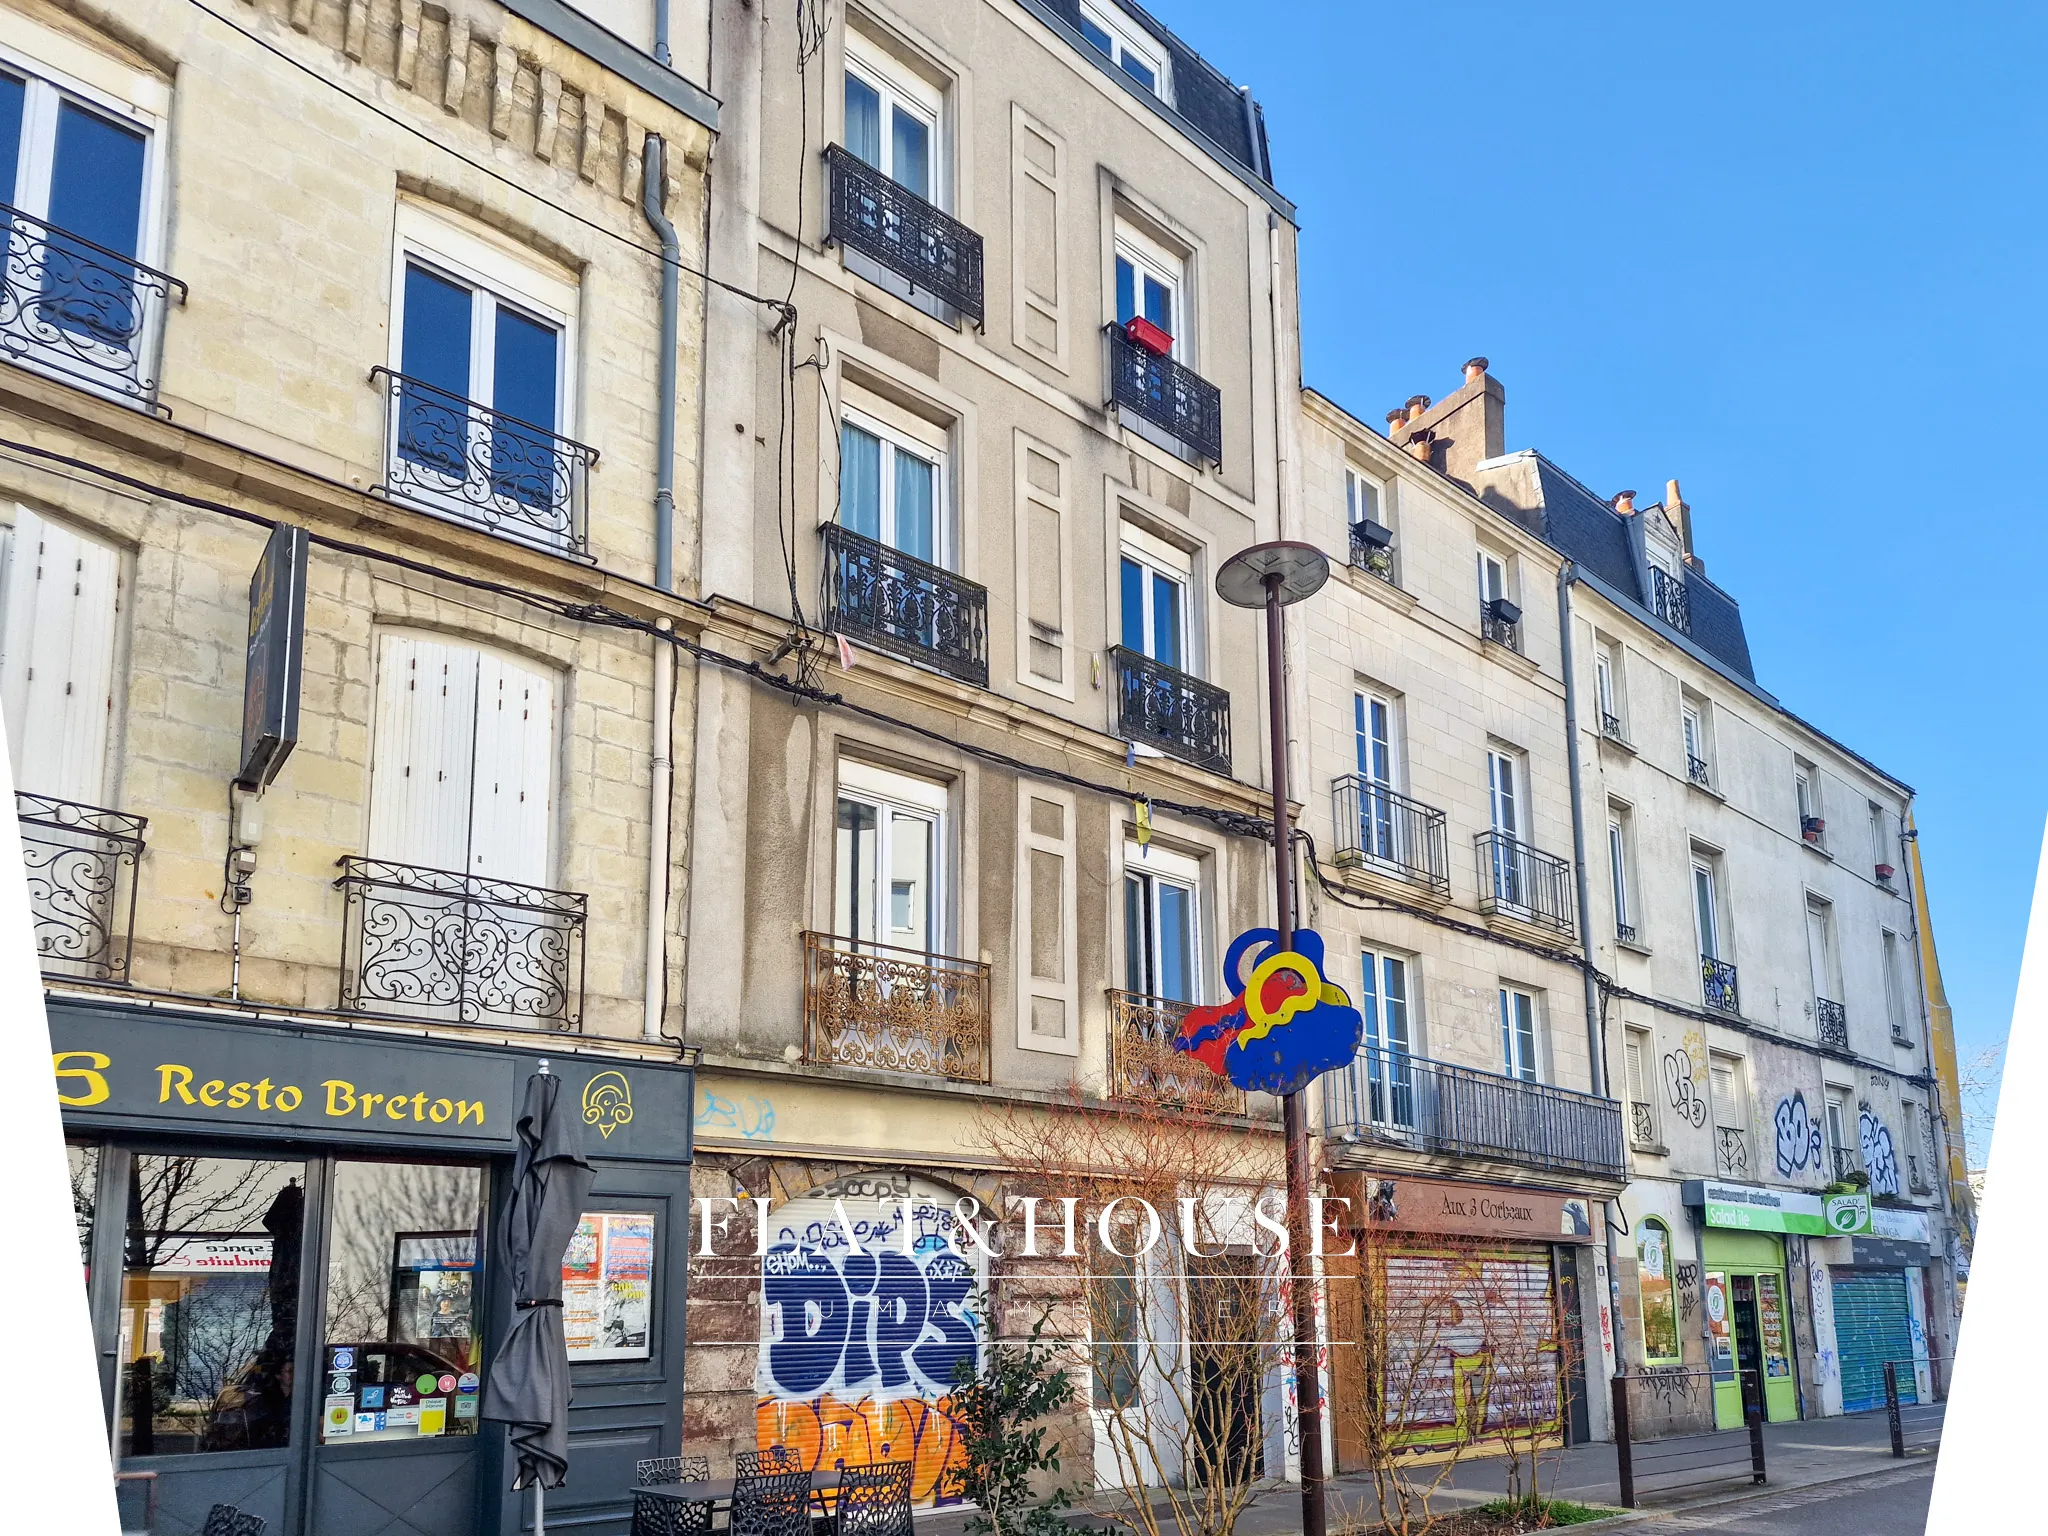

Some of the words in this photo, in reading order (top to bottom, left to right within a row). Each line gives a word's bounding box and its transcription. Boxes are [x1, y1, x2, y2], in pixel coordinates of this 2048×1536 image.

[155, 1064, 303, 1111] Resto
[320, 1079, 485, 1126] Breton
[1441, 1190, 1466, 1216] Aux
[1469, 1197, 1477, 1217] 3
[1481, 1198, 1533, 1224] Corbeaux
